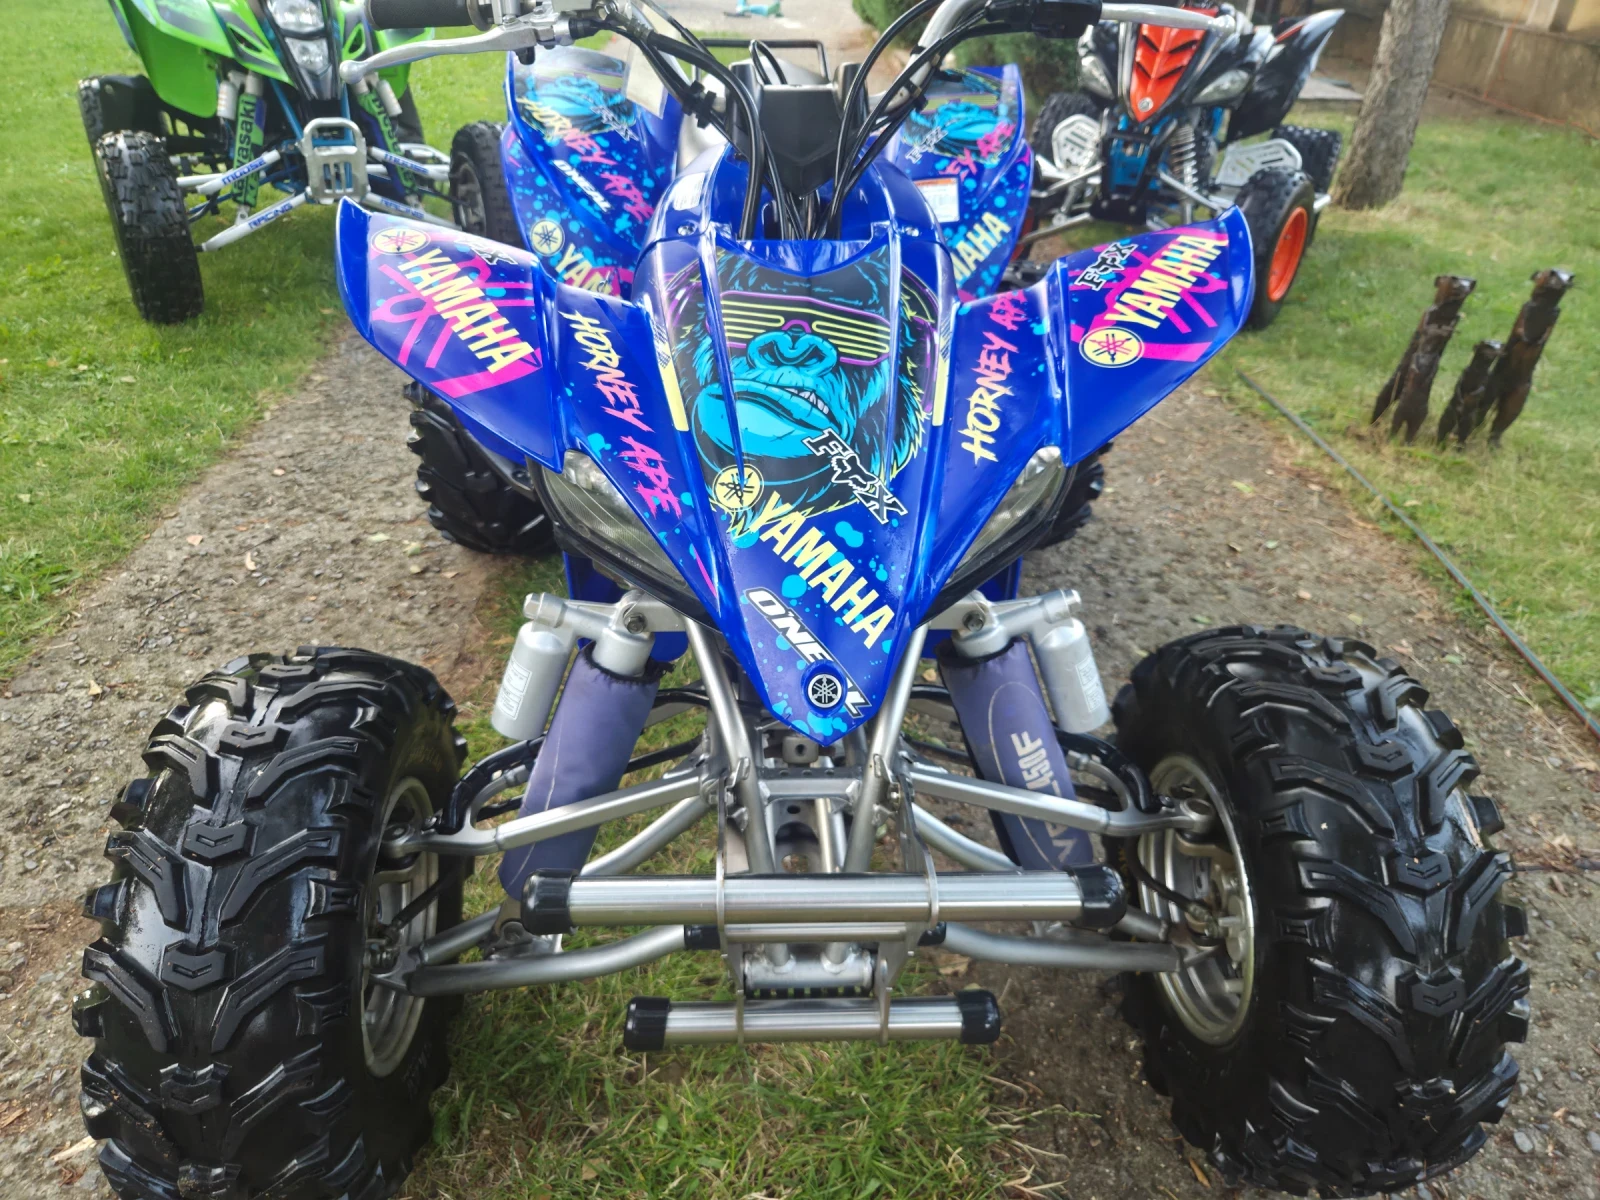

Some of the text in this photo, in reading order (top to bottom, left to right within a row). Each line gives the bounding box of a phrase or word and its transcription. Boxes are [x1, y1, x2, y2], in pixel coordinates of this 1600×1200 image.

[398, 247, 535, 374] YAMAHA
[1106, 235, 1230, 329] YAMAHA
[559, 311, 683, 520] HORNEY APE
[958, 332, 1019, 464] HORNEY
[750, 491, 895, 650] YAMAHA
[746, 588, 872, 718] O'NEL
